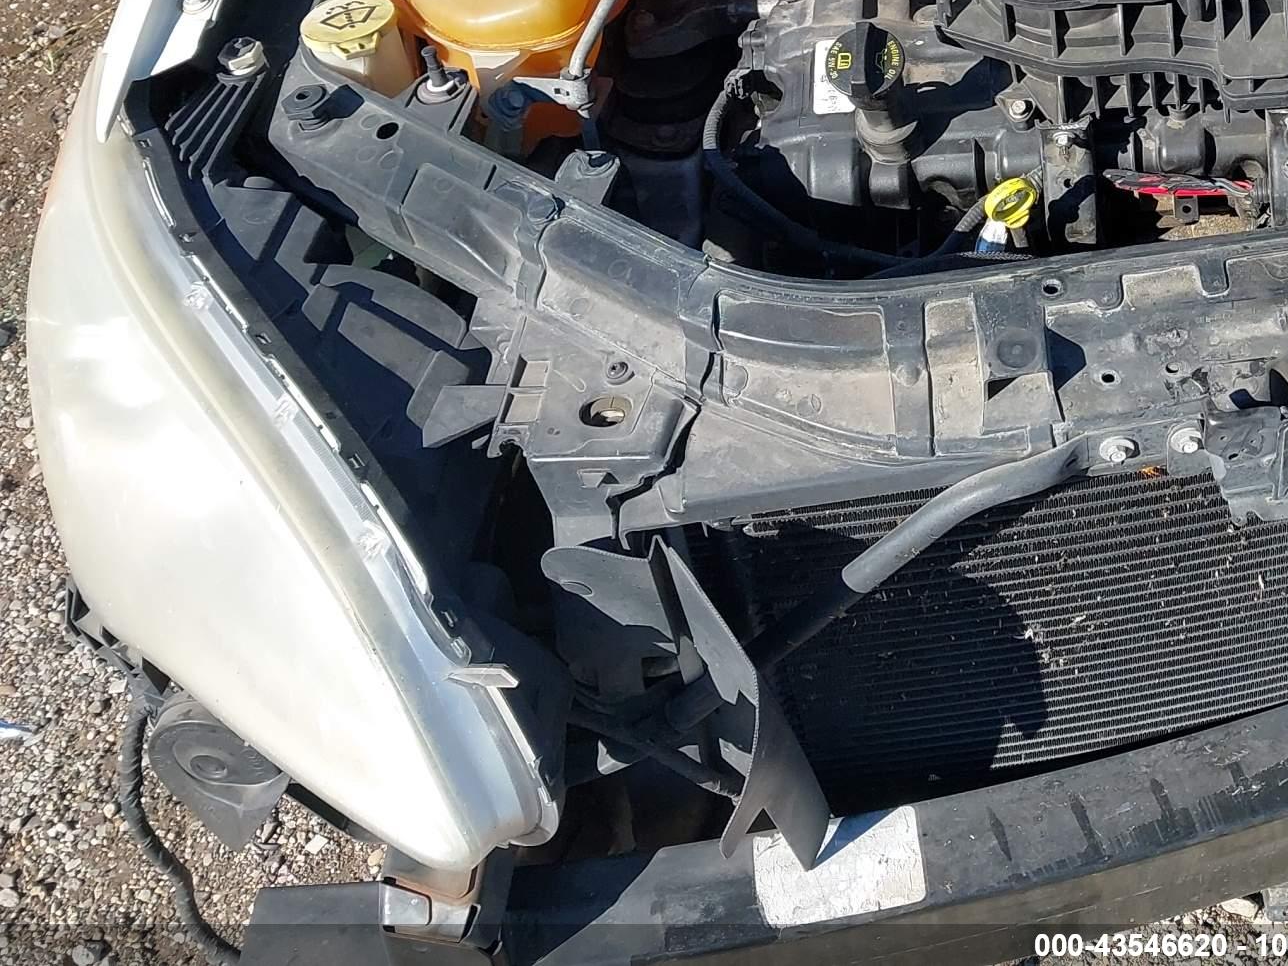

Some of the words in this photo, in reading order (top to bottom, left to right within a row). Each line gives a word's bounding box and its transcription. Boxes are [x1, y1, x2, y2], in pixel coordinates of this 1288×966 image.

[830, 41, 842, 55] SAE
[886, 40, 900, 66] ENGINE
[884, 68, 896, 80] OIL
